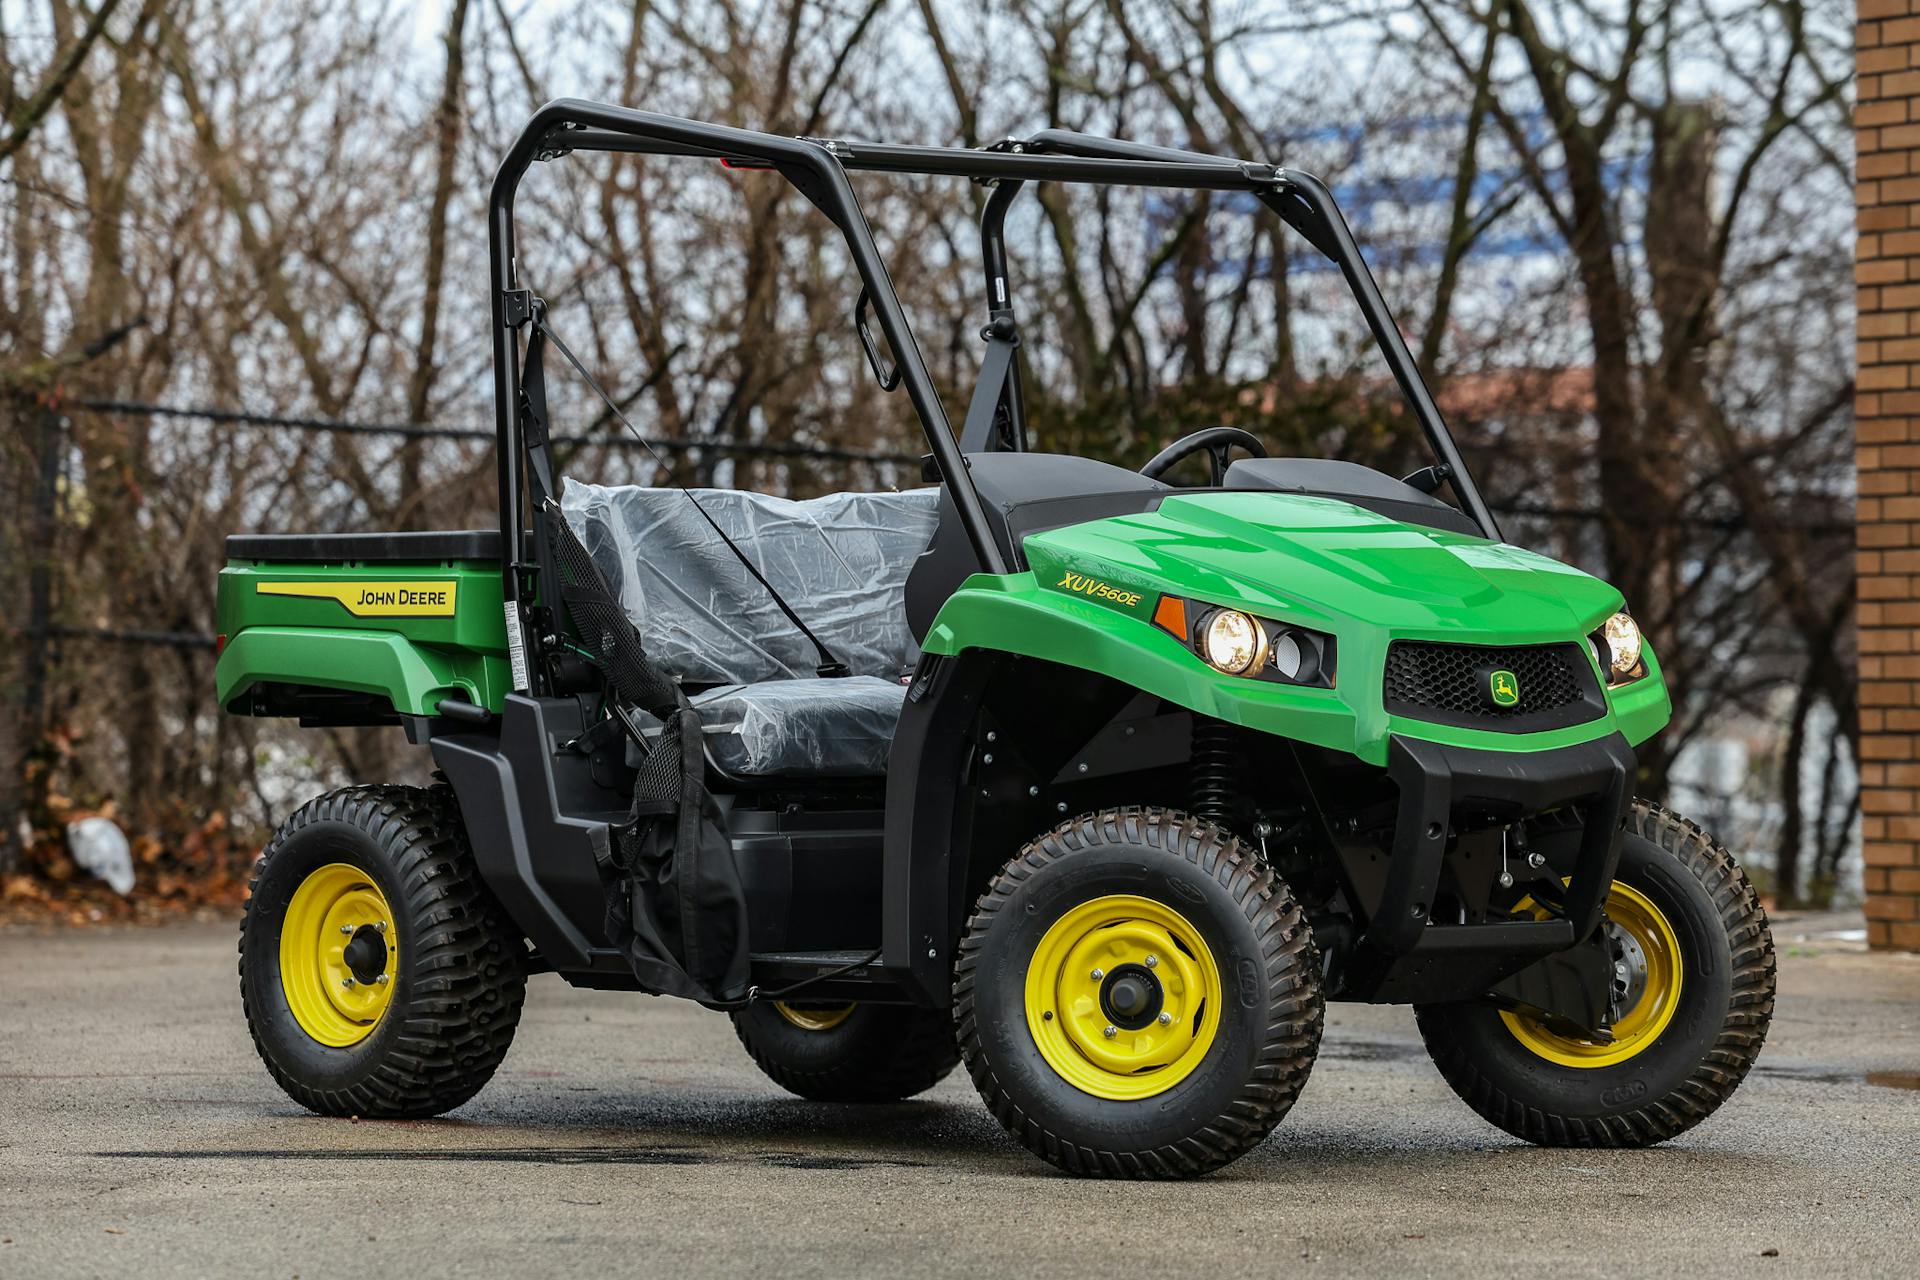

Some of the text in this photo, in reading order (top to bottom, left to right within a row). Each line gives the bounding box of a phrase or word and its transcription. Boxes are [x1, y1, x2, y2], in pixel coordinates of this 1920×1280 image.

[357, 589, 446, 605] JOHN DEERE
[1057, 571, 1141, 607] XUV560E
